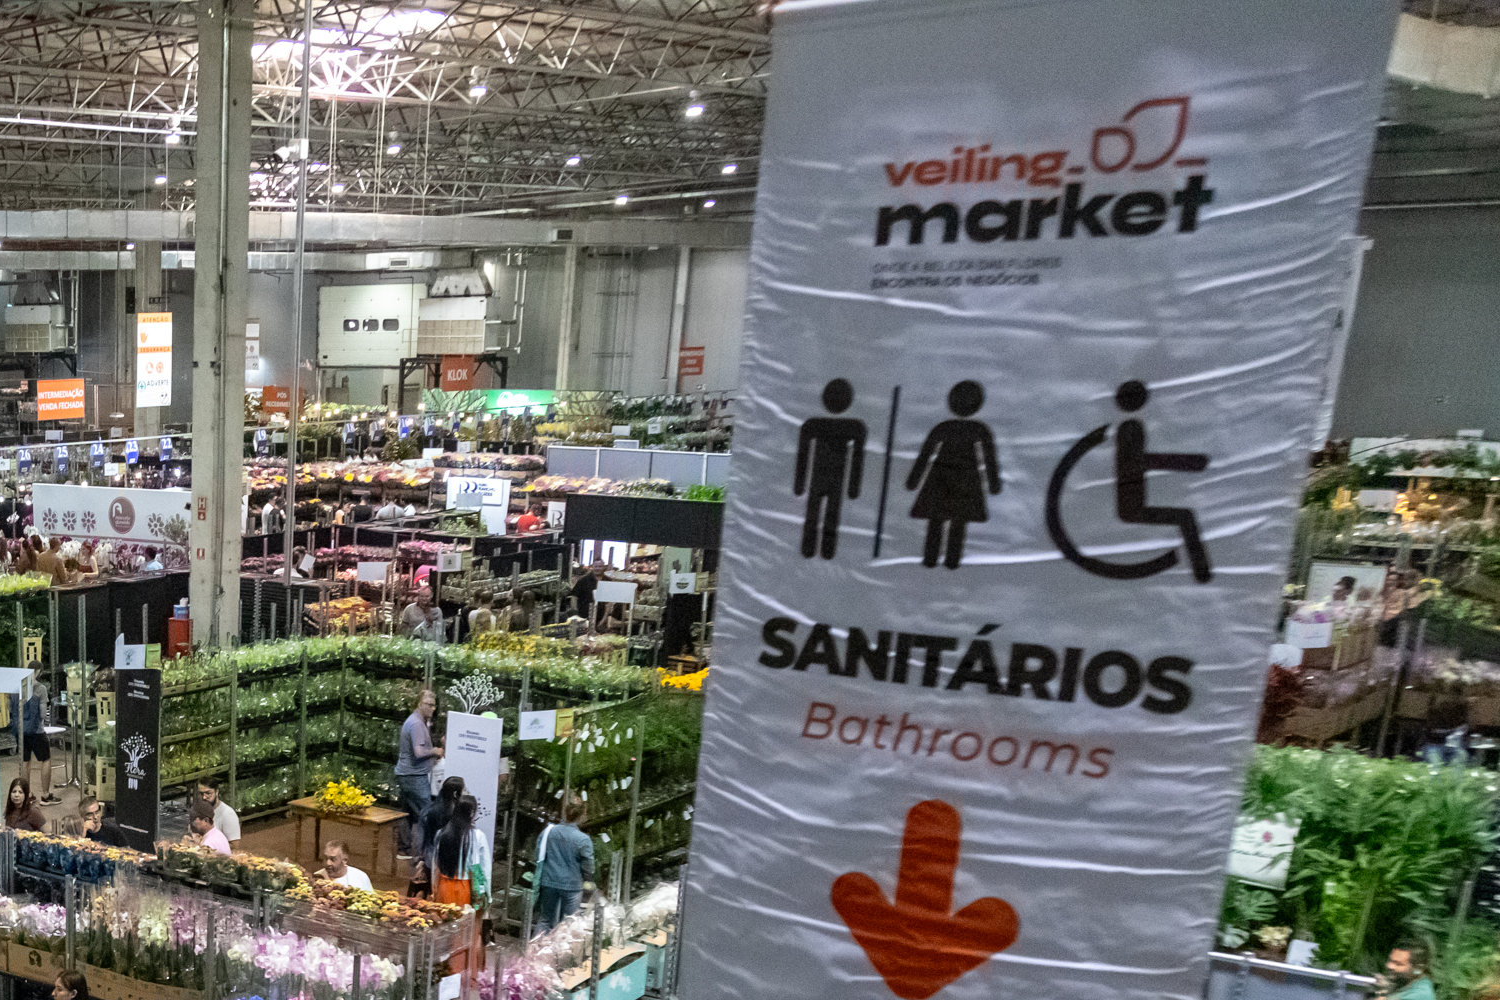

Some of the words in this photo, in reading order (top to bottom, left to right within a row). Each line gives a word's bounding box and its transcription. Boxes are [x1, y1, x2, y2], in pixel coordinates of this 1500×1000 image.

[885, 142, 1068, 188] veiling
[875, 174, 1216, 247] market
[447, 368, 468, 381] KLOK
[147, 379, 169, 387] ADVERTE
[38, 388, 84, 400] INTERMEDIAÇÃO
[39, 402, 57, 411] VENDA
[58, 401, 84, 410] FECHADA
[257, 429, 268, 441] 19
[93, 443, 104, 455] 24
[127, 441, 138, 451] 23
[161, 438, 172, 449] 22
[19, 449, 31, 461] 26
[57, 446, 69, 458] 25
[758, 615, 1197, 714] SANITÁRIOS
[802, 701, 1115, 779] Bathrooms
